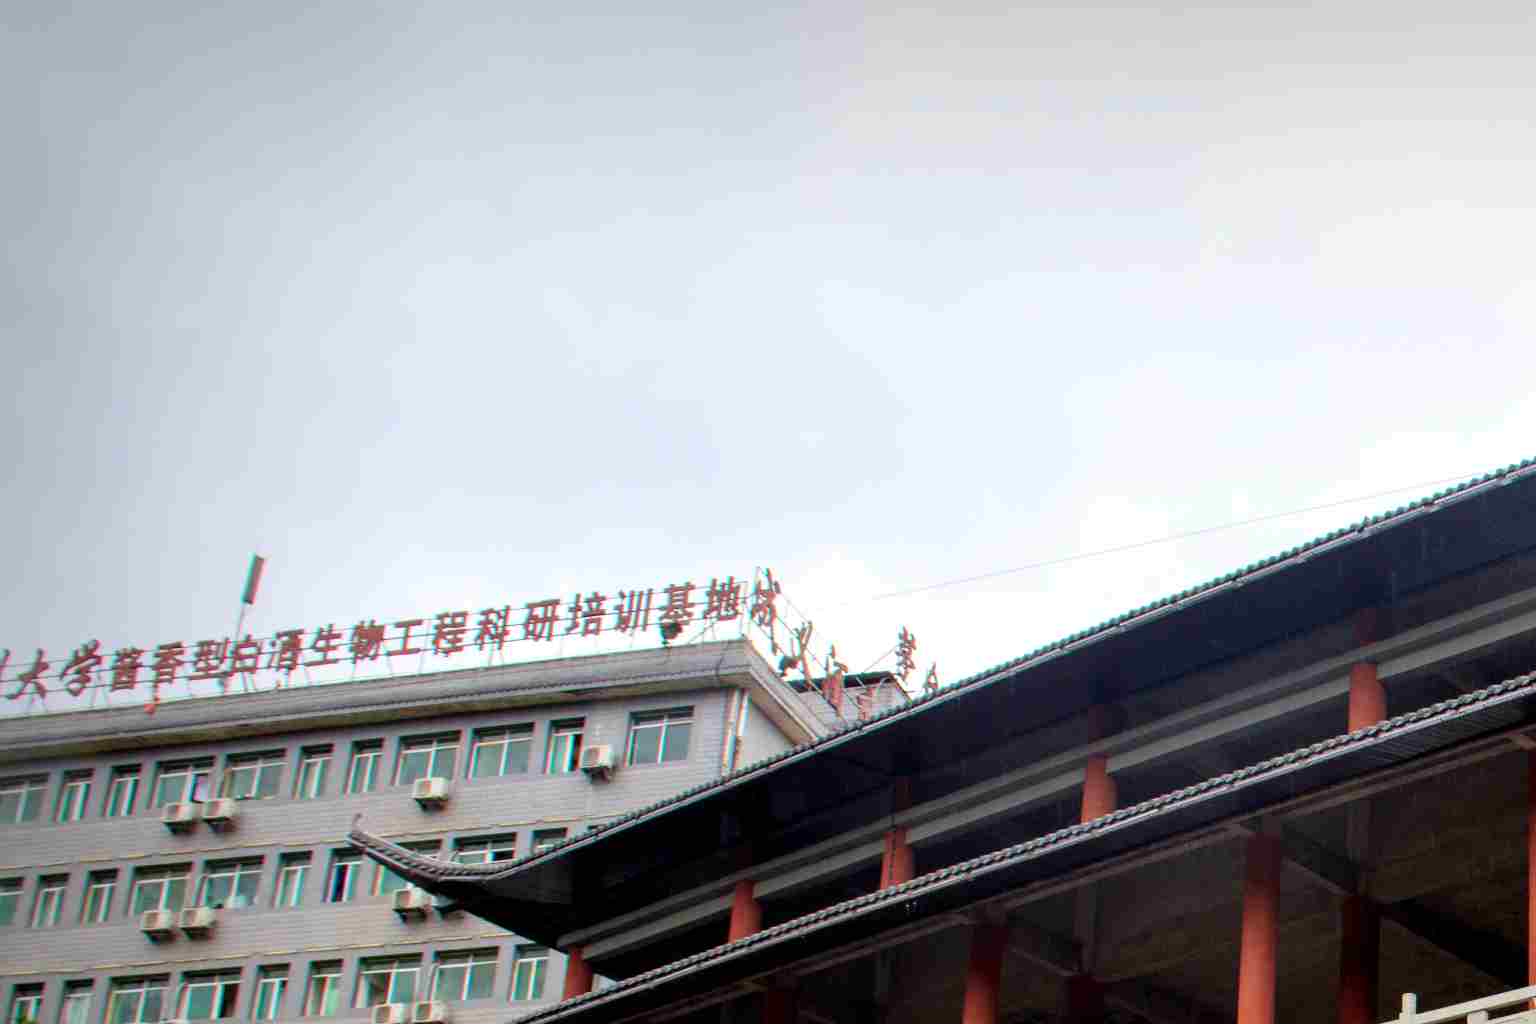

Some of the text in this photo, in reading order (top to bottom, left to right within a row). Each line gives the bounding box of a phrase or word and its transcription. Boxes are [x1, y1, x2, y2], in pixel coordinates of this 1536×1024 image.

[0, 576, 742, 699] 大学酱香型白酒生物工程科研培训基地
